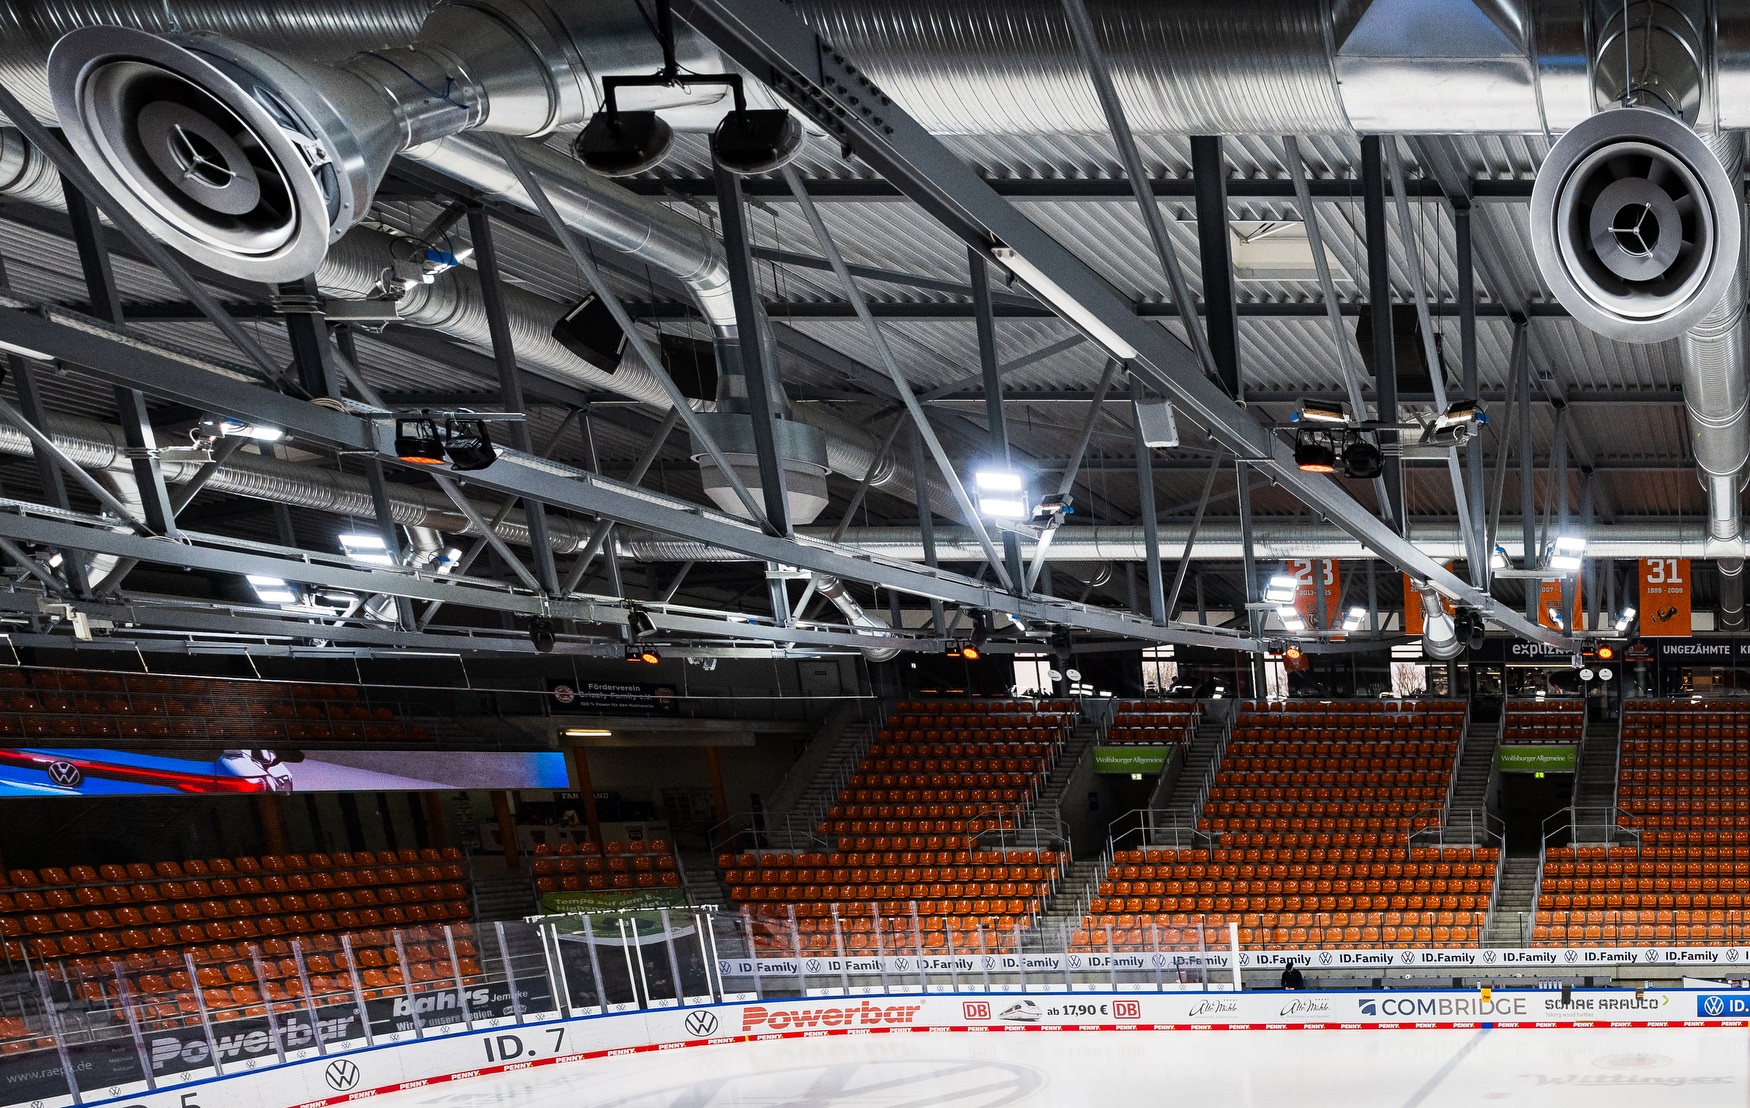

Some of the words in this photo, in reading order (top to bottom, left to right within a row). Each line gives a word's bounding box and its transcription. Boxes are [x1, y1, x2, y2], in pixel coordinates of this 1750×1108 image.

[1647, 559, 1683, 584] 31
[1663, 643, 1731, 655] UNGEZÄHMTE
[588, 683, 640, 692] Förderverein
[1089, 957, 1144, 968] ID.Family
[1256, 955, 1311, 966] ID.Family
[1421, 953, 1475, 964] ID.Family
[1584, 952, 1638, 963] ID.Family
[966, 1004, 987, 1017] DB
[1047, 1007, 1059, 1016] ab
[1063, 1004, 1096, 1017] 17,90
[1100, 1004, 1108, 1015] €
[1116, 1003, 1137, 1016] DB
[1382, 998, 1527, 1016] COMBRIDGE
[1729, 999, 1749, 1012] ID.
[742, 1001, 920, 1031] Powerbar
[396, 1021, 414, 1031] Wir
[429, 1016, 463, 1027] unsere
[483, 1034, 536, 1062] ID.
[545, 1027, 565, 1053] 7
